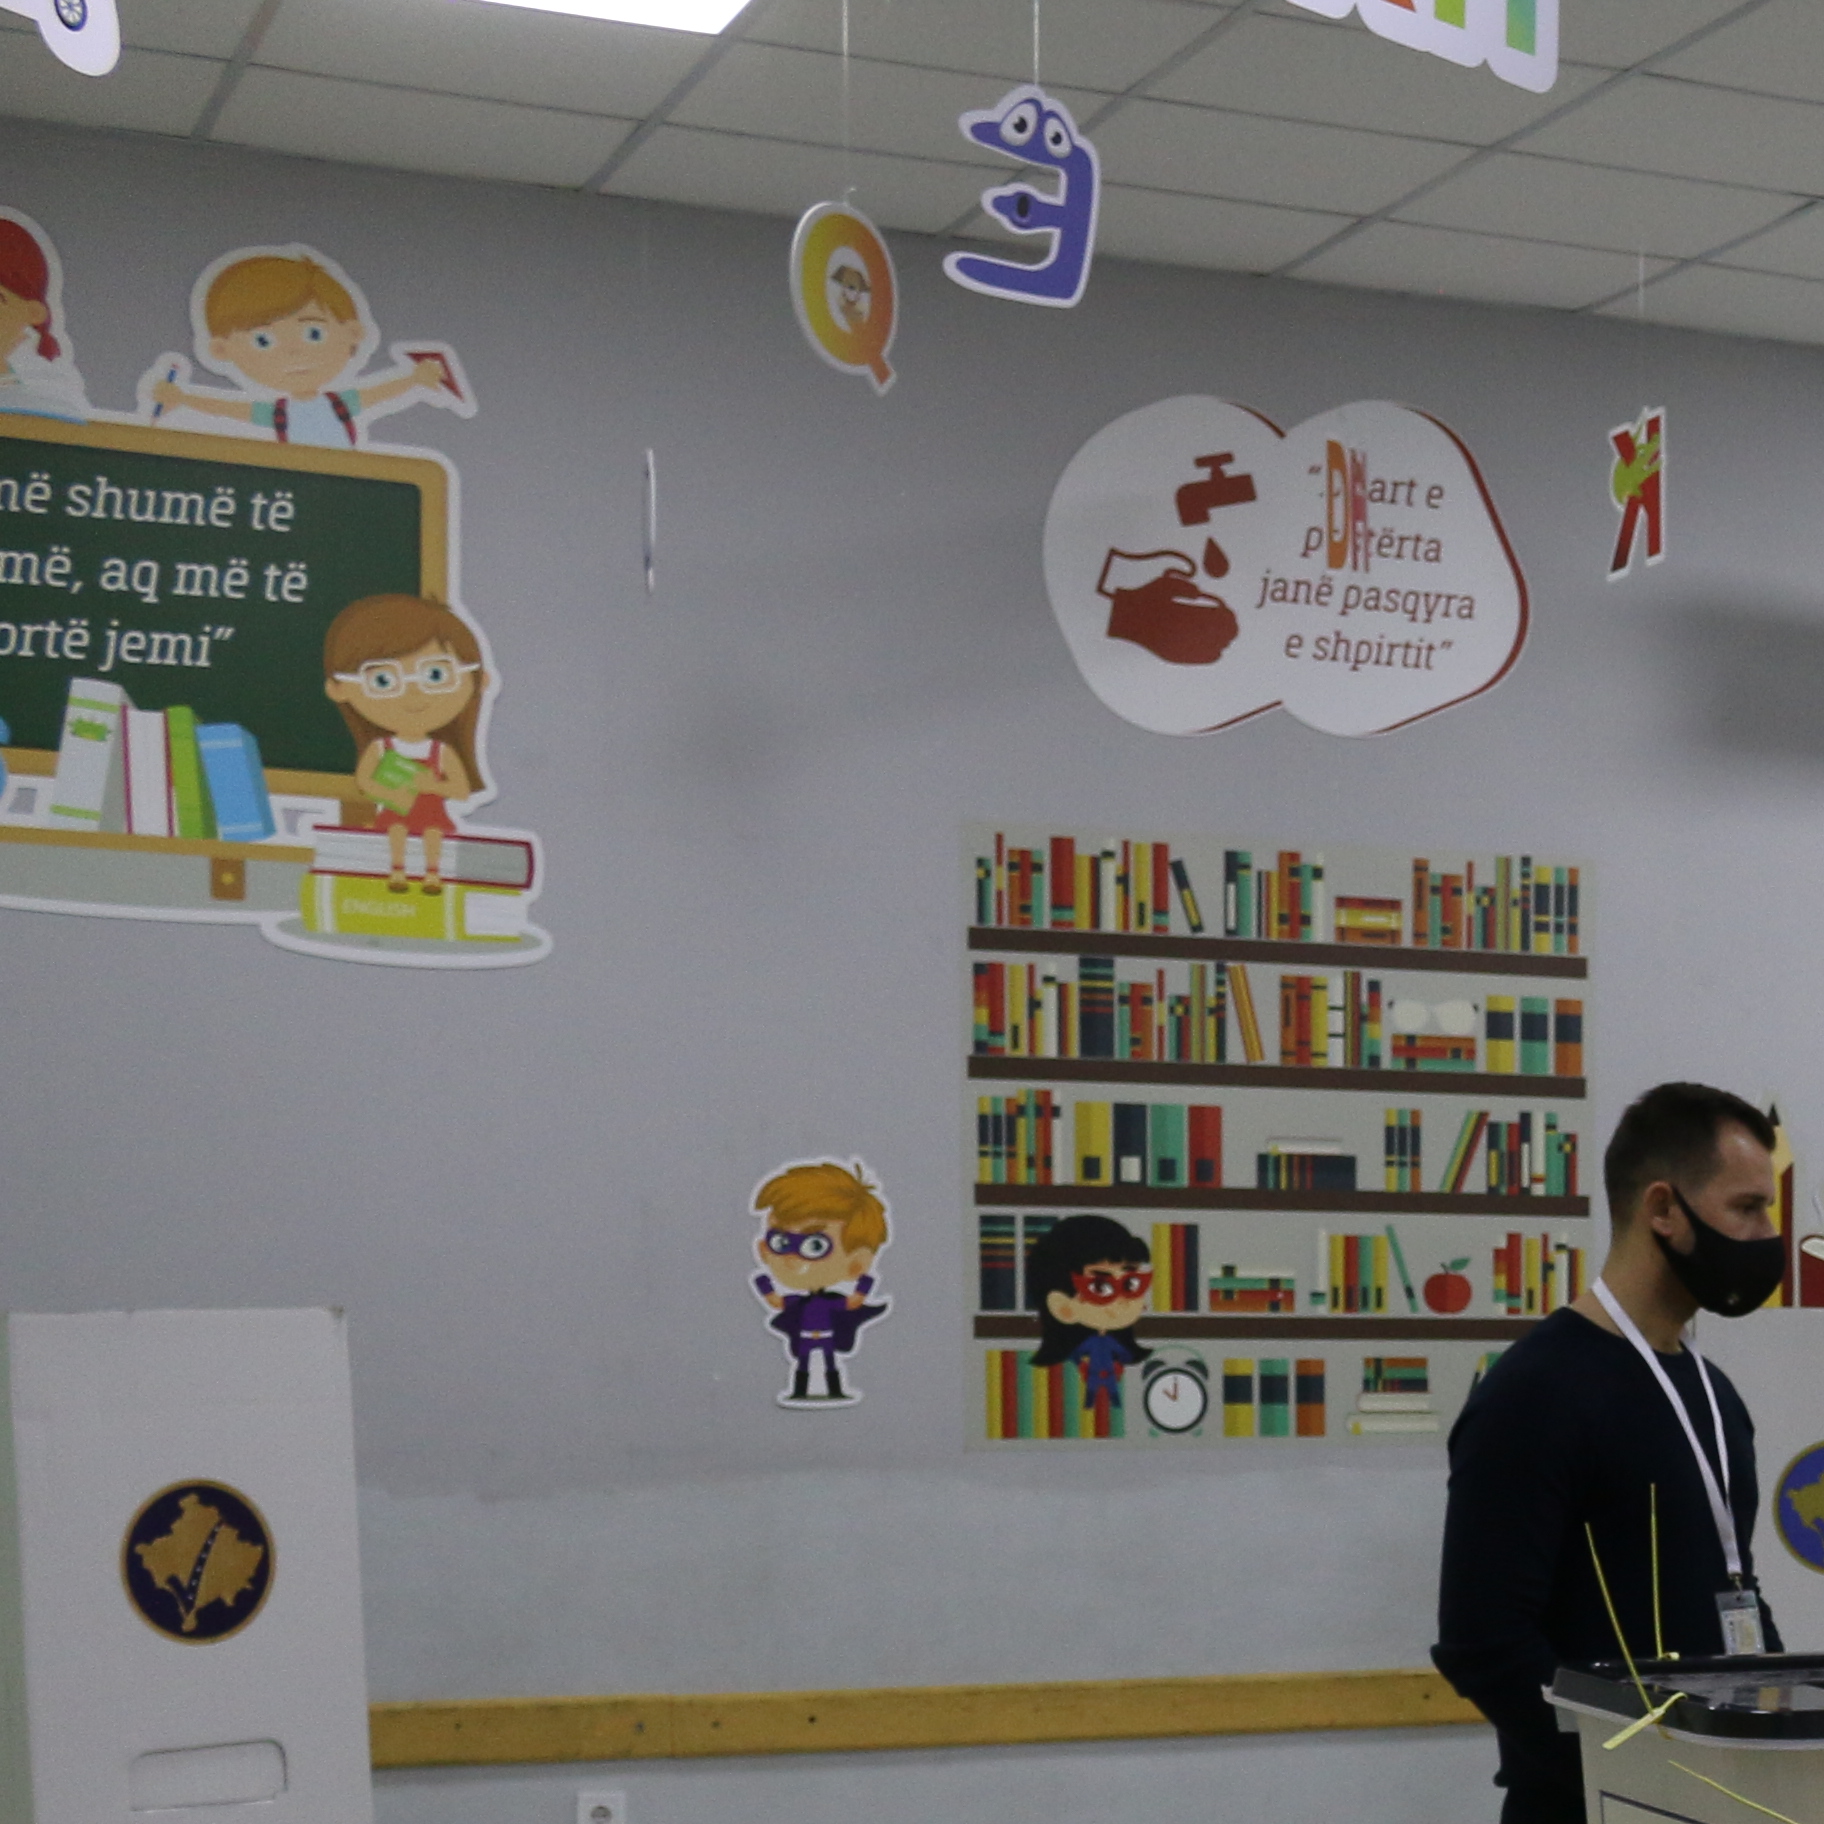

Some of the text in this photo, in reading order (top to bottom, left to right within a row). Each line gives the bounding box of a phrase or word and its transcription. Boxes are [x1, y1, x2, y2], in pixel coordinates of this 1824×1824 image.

[802, 212, 895, 385] Q
[65, 475, 237, 529] shumë
[250, 490, 296, 533] të
[1425, 483, 1446, 510] e
[100, 557, 160, 604] aq
[172, 557, 250, 600] më
[263, 561, 309, 603] të
[1255, 568, 1475, 624] janë pasqyra
[1284, 632, 1304, 660] e
